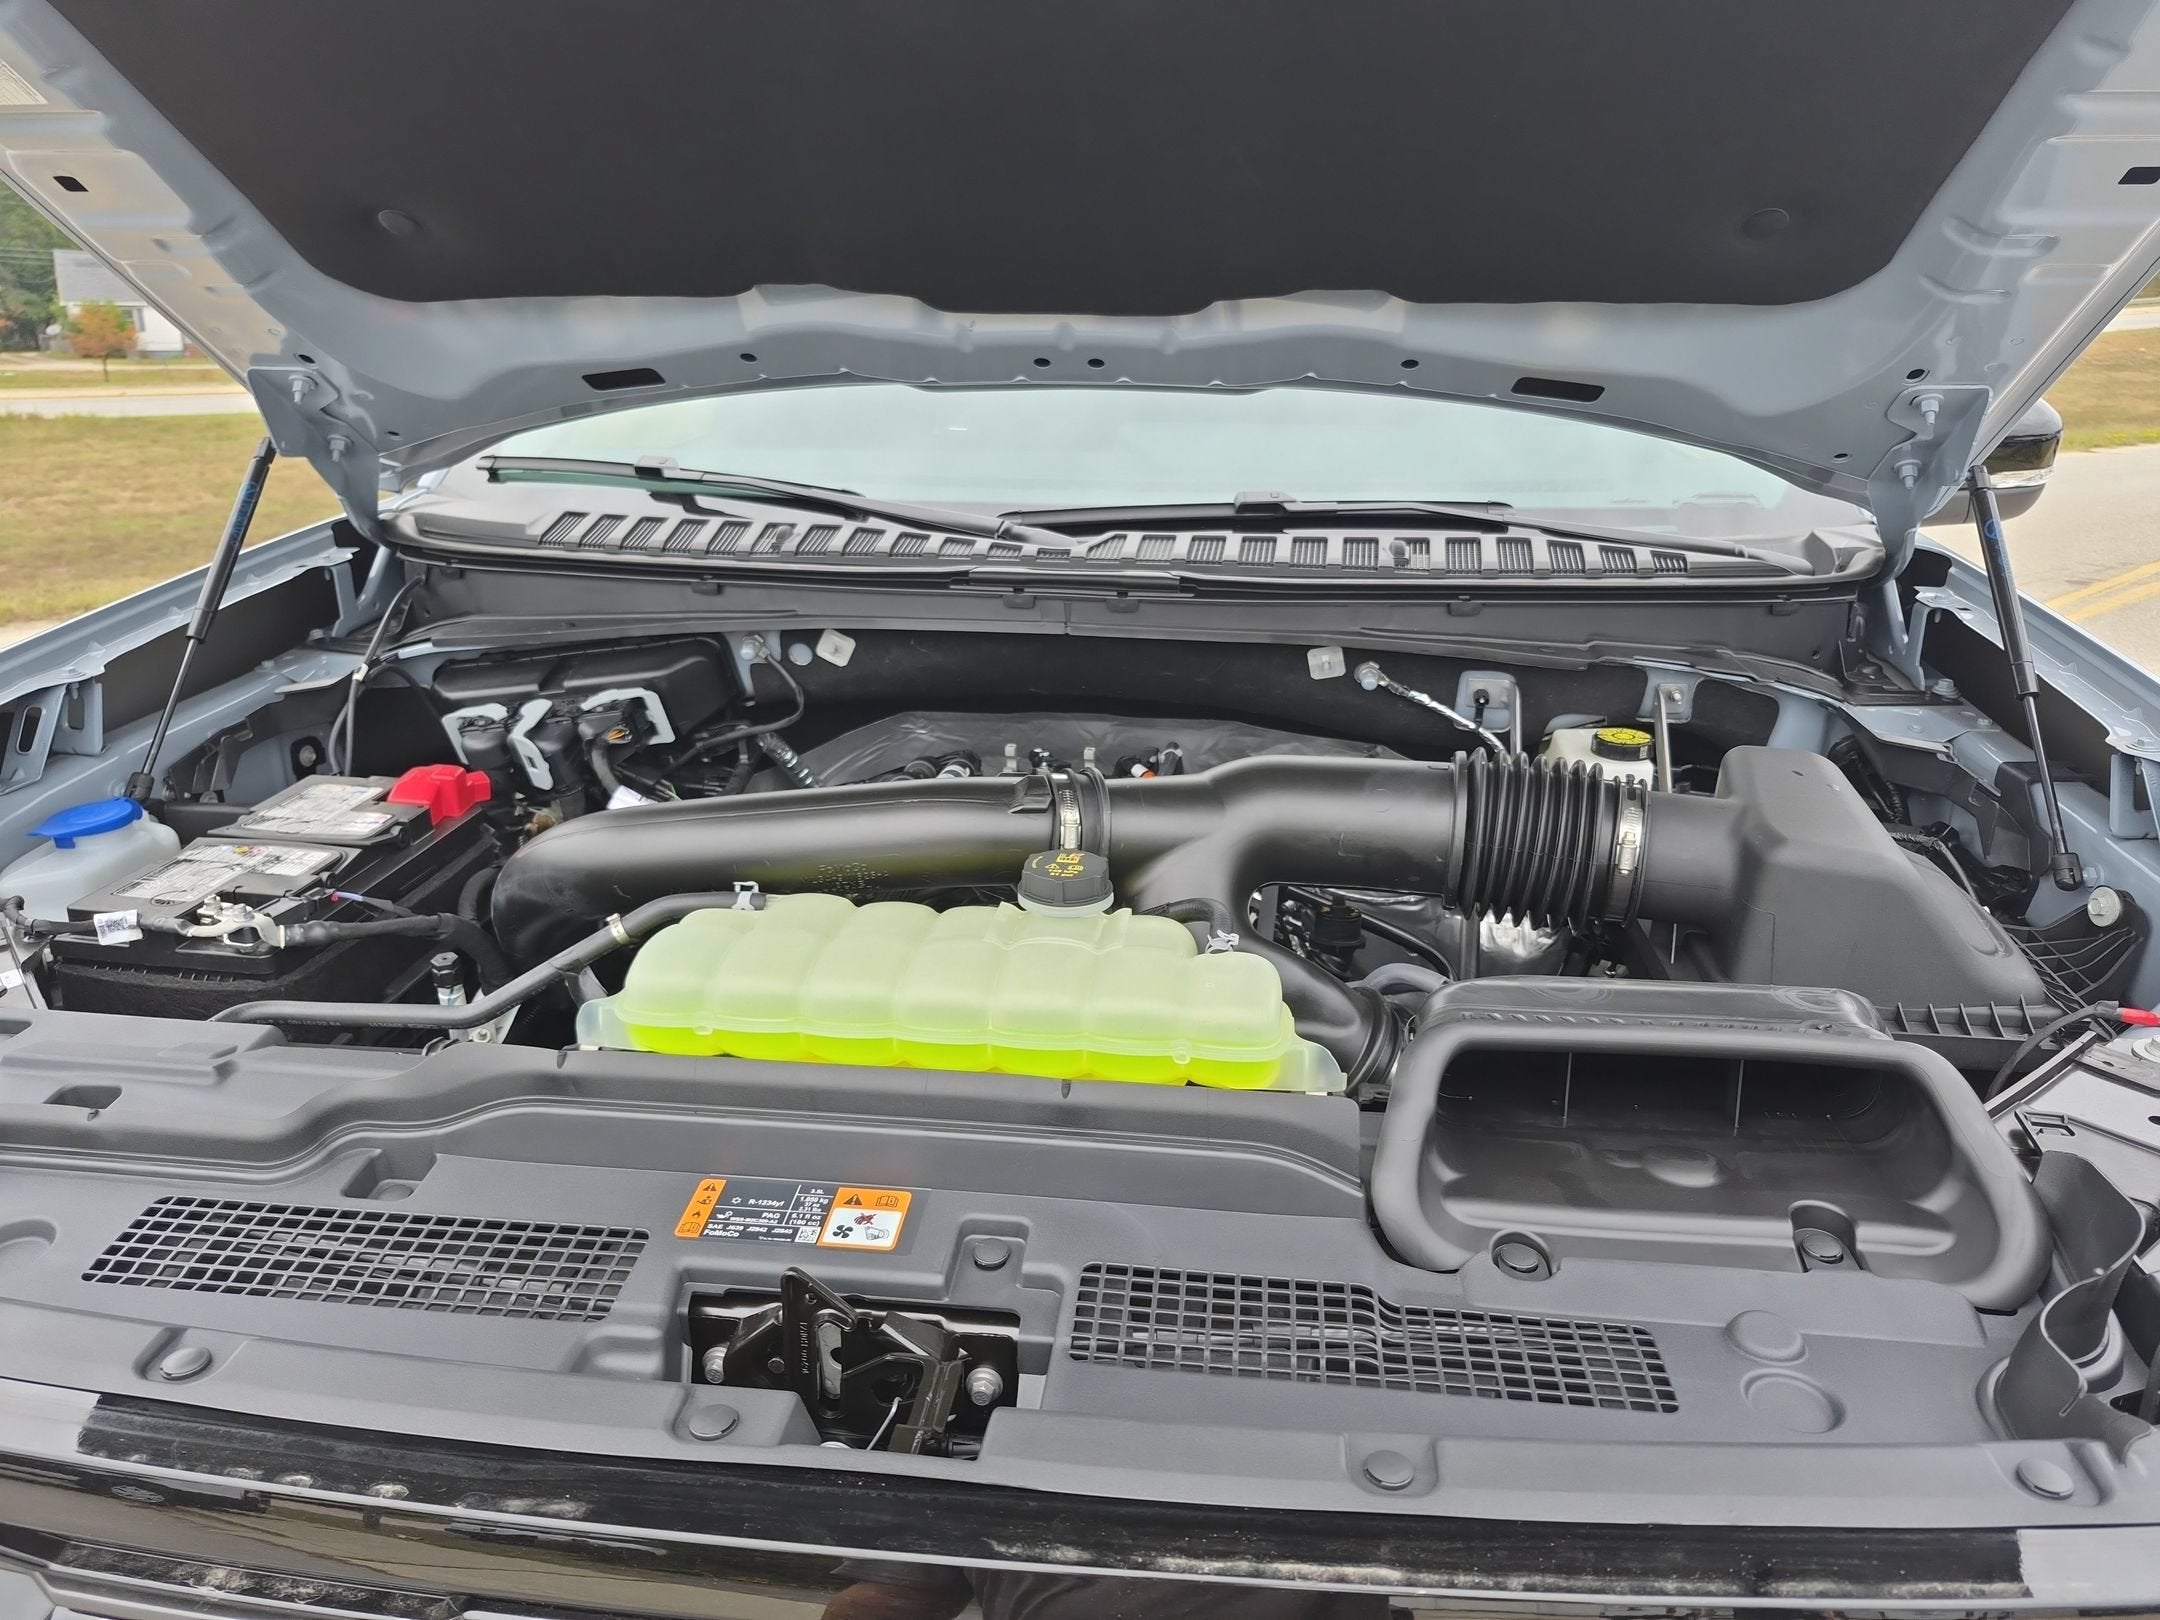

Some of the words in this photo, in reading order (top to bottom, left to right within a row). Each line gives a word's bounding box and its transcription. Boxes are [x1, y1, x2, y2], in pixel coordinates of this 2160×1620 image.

[748, 1198, 785, 1208] R-1234yf
[819, 1196, 829, 1205] kg
[703, 1229, 740, 1237] FoMoCo
